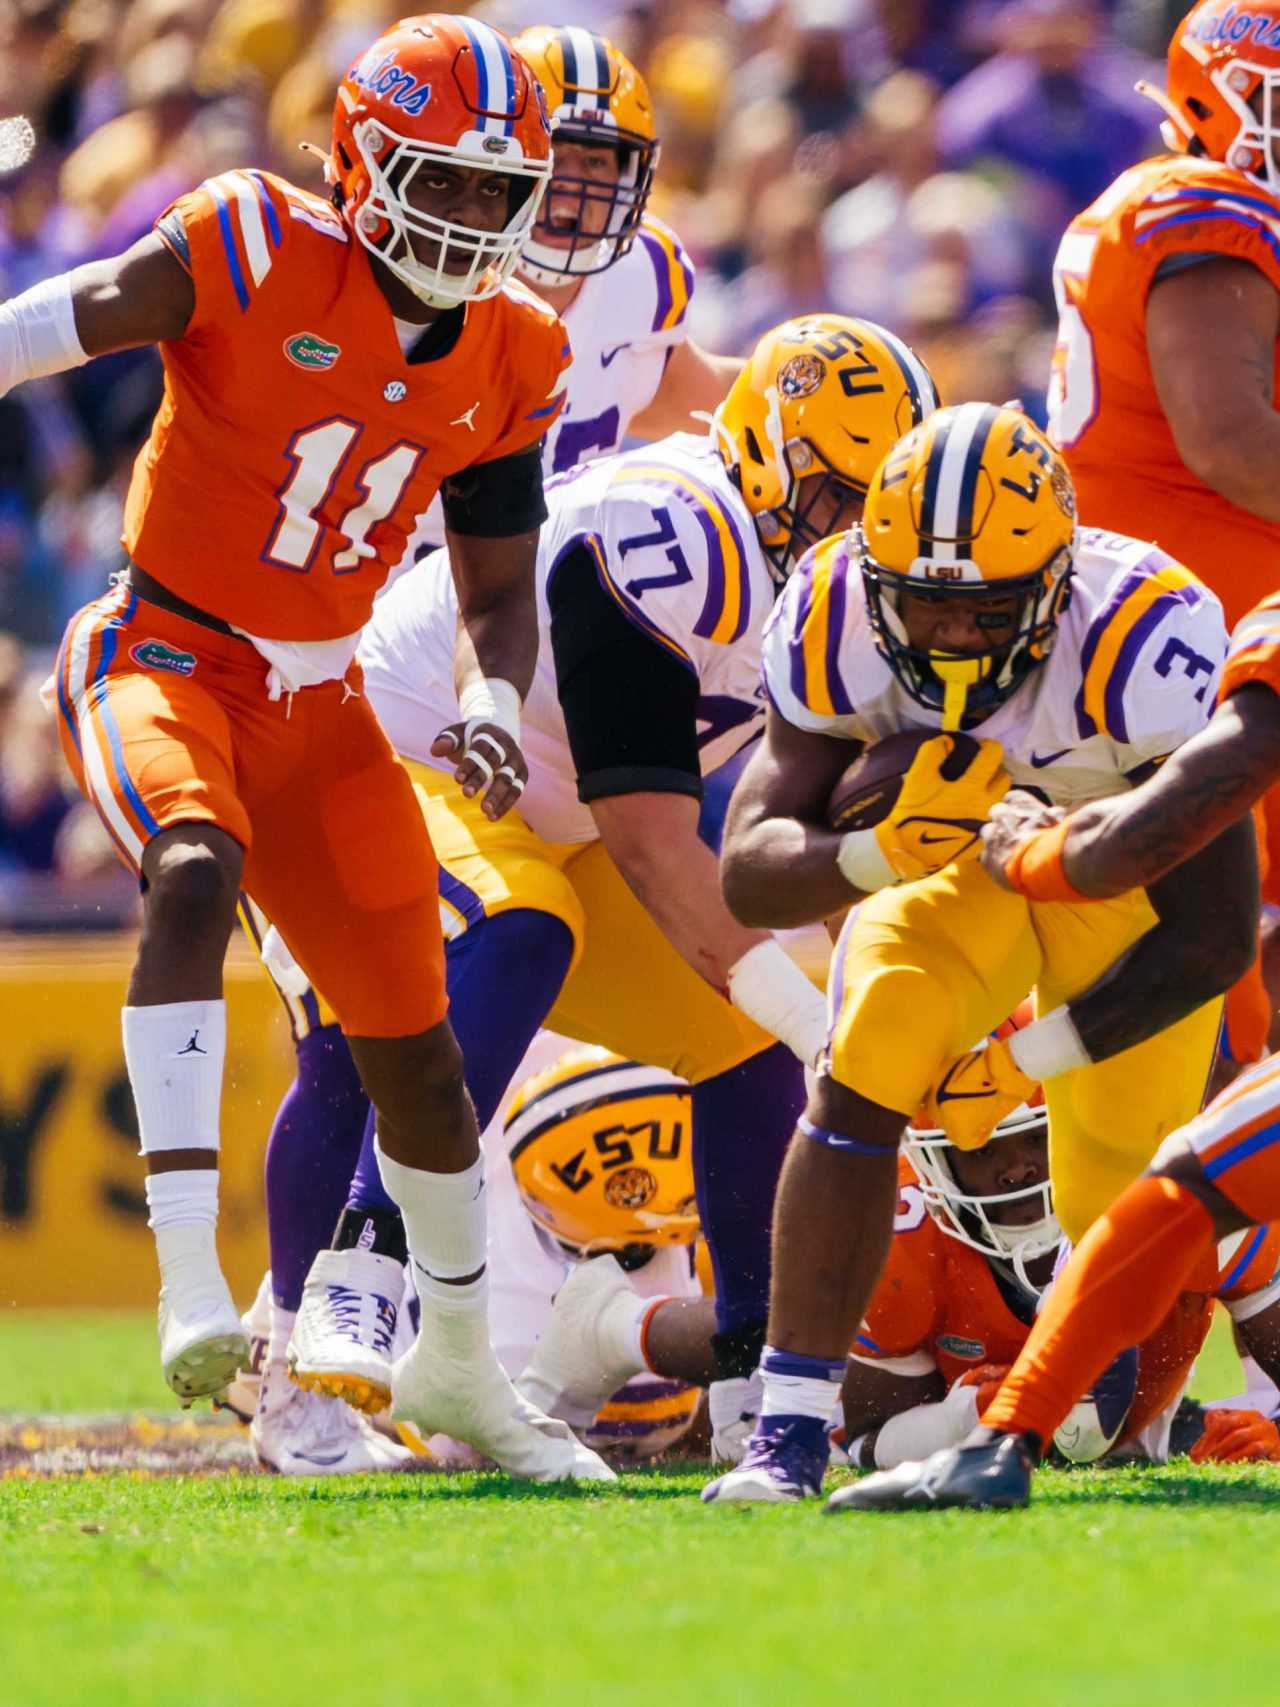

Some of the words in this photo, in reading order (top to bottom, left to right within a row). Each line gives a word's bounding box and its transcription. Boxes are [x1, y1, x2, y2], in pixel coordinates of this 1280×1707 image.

[784, 324, 884, 397] SU
[260, 415, 426, 574] 11
[618, 507, 693, 598] 77
[924, 564, 963, 581] LSU
[1153, 636, 1216, 704] 3
[550, 1120, 683, 1194] LSU
